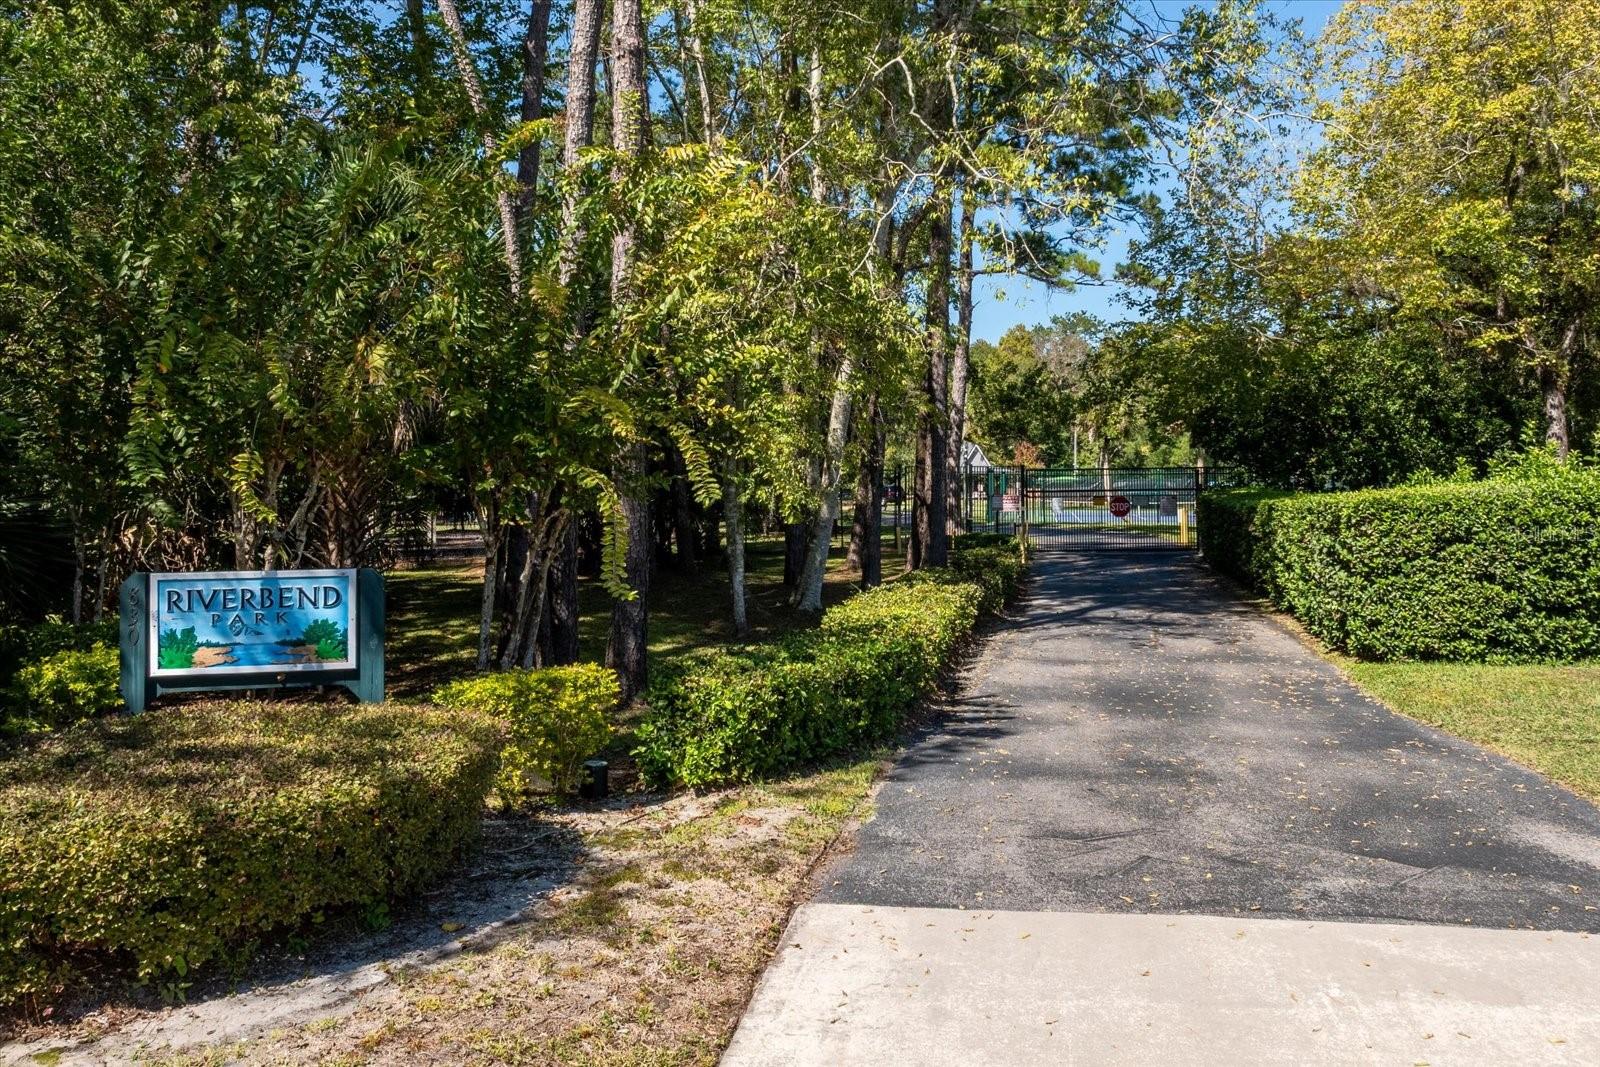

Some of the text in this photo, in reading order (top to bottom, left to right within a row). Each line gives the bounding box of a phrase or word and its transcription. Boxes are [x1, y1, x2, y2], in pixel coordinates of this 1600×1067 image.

[1111, 502, 1129, 511] STOP
[166, 585, 342, 614] RIVERBEND
[211, 611, 289, 628] PARK
